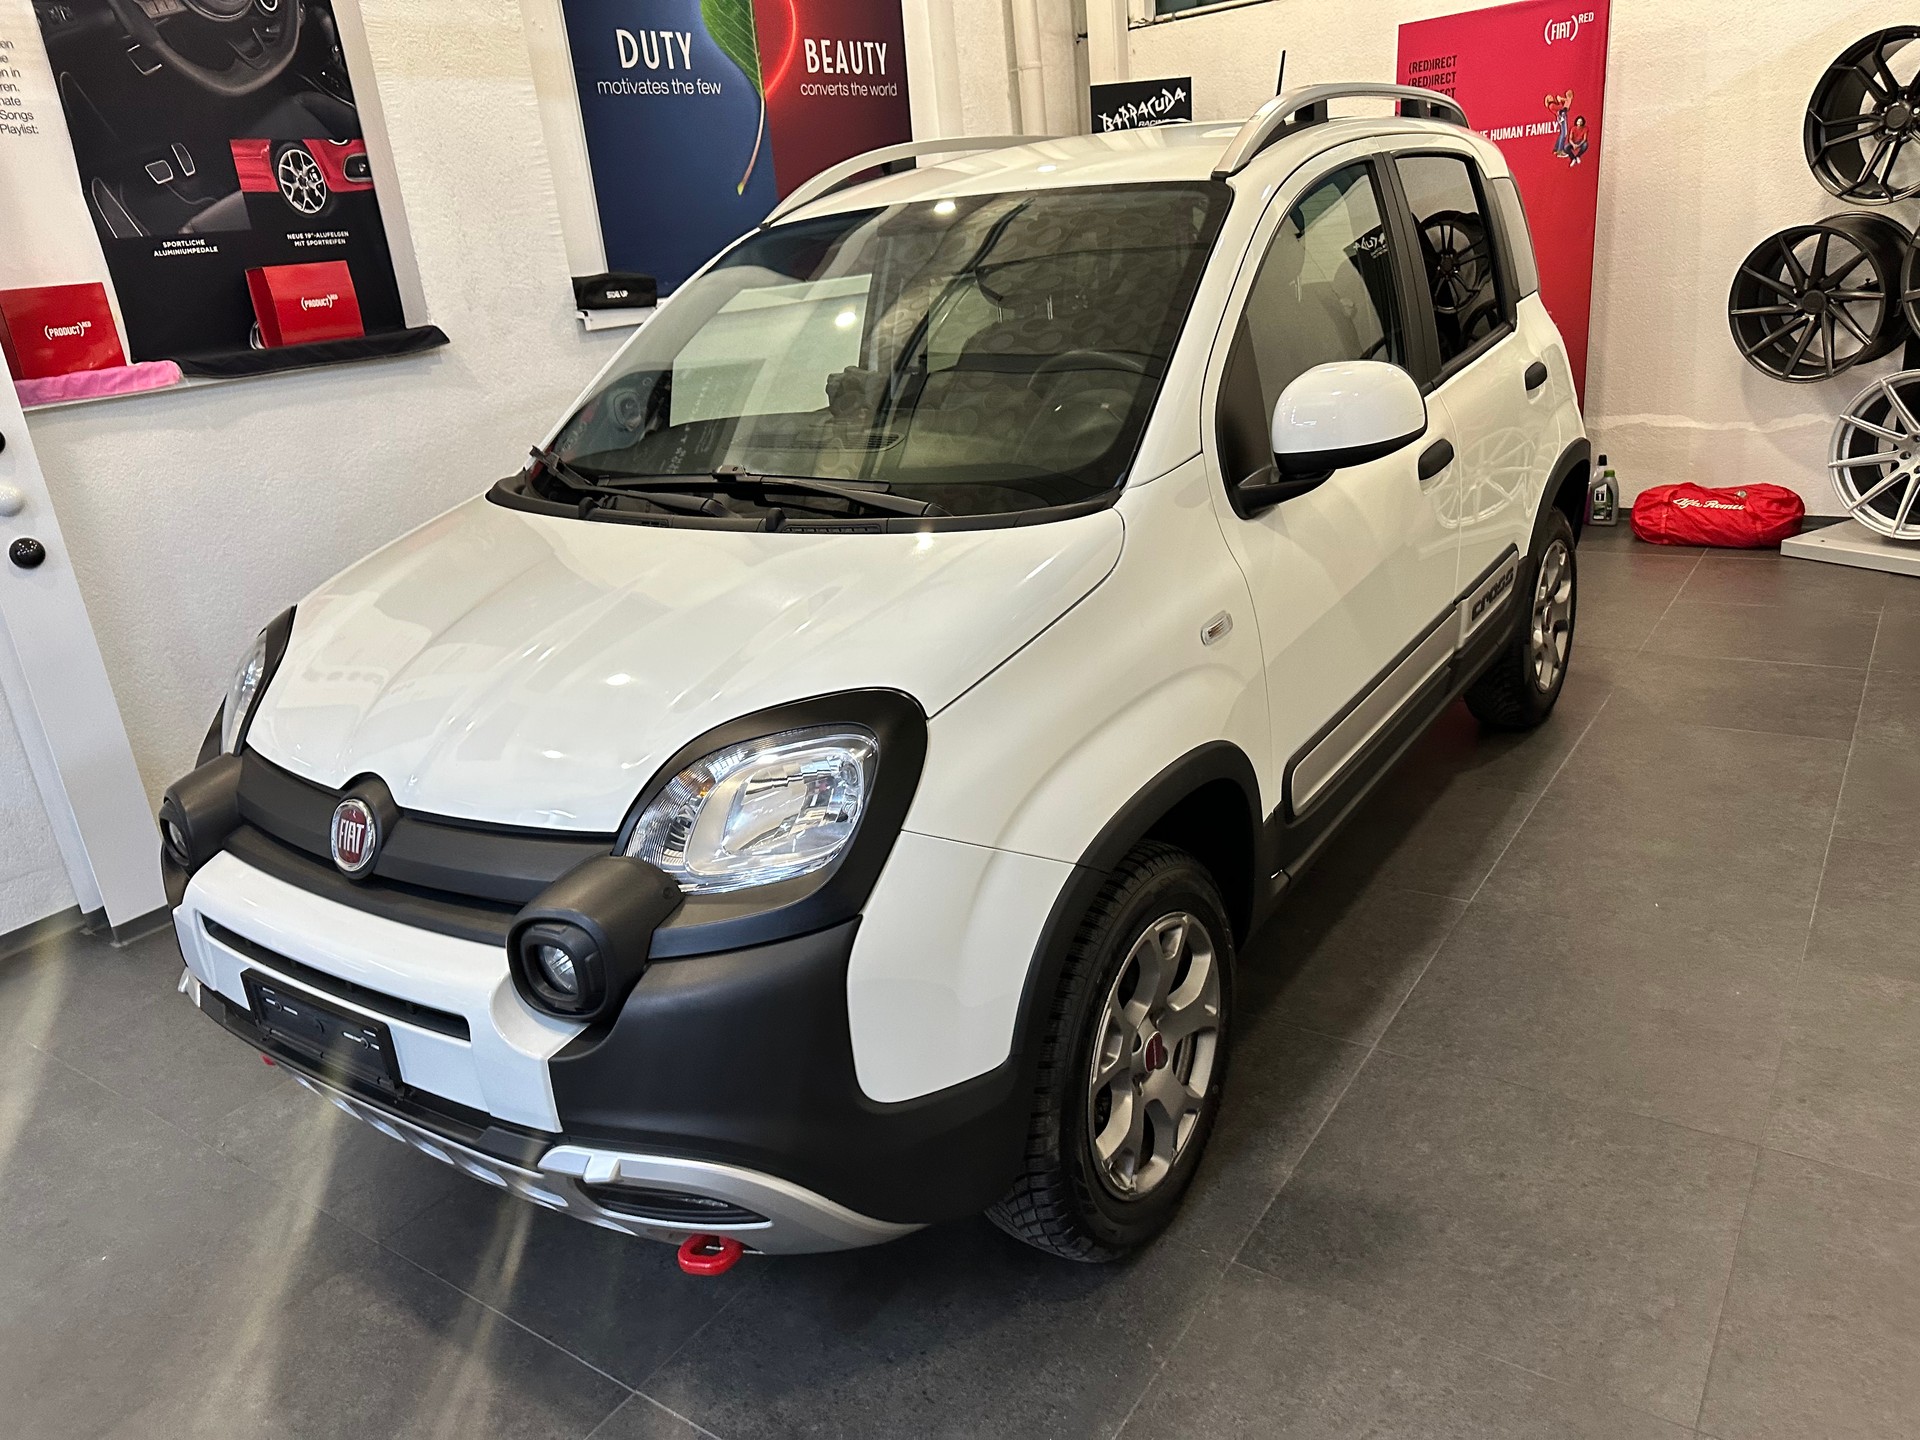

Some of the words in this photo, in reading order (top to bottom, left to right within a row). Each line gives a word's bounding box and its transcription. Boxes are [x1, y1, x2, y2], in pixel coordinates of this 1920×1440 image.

[616, 29, 691, 70] DUTY
[804, 38, 887, 75] BEAUTY
[1409, 55, 1457, 74] (RED)IRECT
[10, 67, 21, 78] in
[597, 78, 669, 95] motivates
[671, 78, 694, 95] the
[697, 78, 721, 95] few
[800, 82, 849, 96] converts
[851, 82, 868, 96] the
[869, 82, 897, 96] world
[0, 109, 34, 122] Songs
[1098, 87, 1186, 132] BARRACUDA
[0, 123, 39, 136] Playlist:
[1490, 126, 1523, 141] HUMAN
[1525, 121, 1560, 137] FAMILY.
[153, 246, 219, 257] ALUMINIUMPEDALE
[162, 239, 206, 249] SPORTLICHE
[1673, 498, 1702, 509] Alfa
[1703, 500, 1745, 511] Romeo
[338, 818, 365, 854] FIAT
